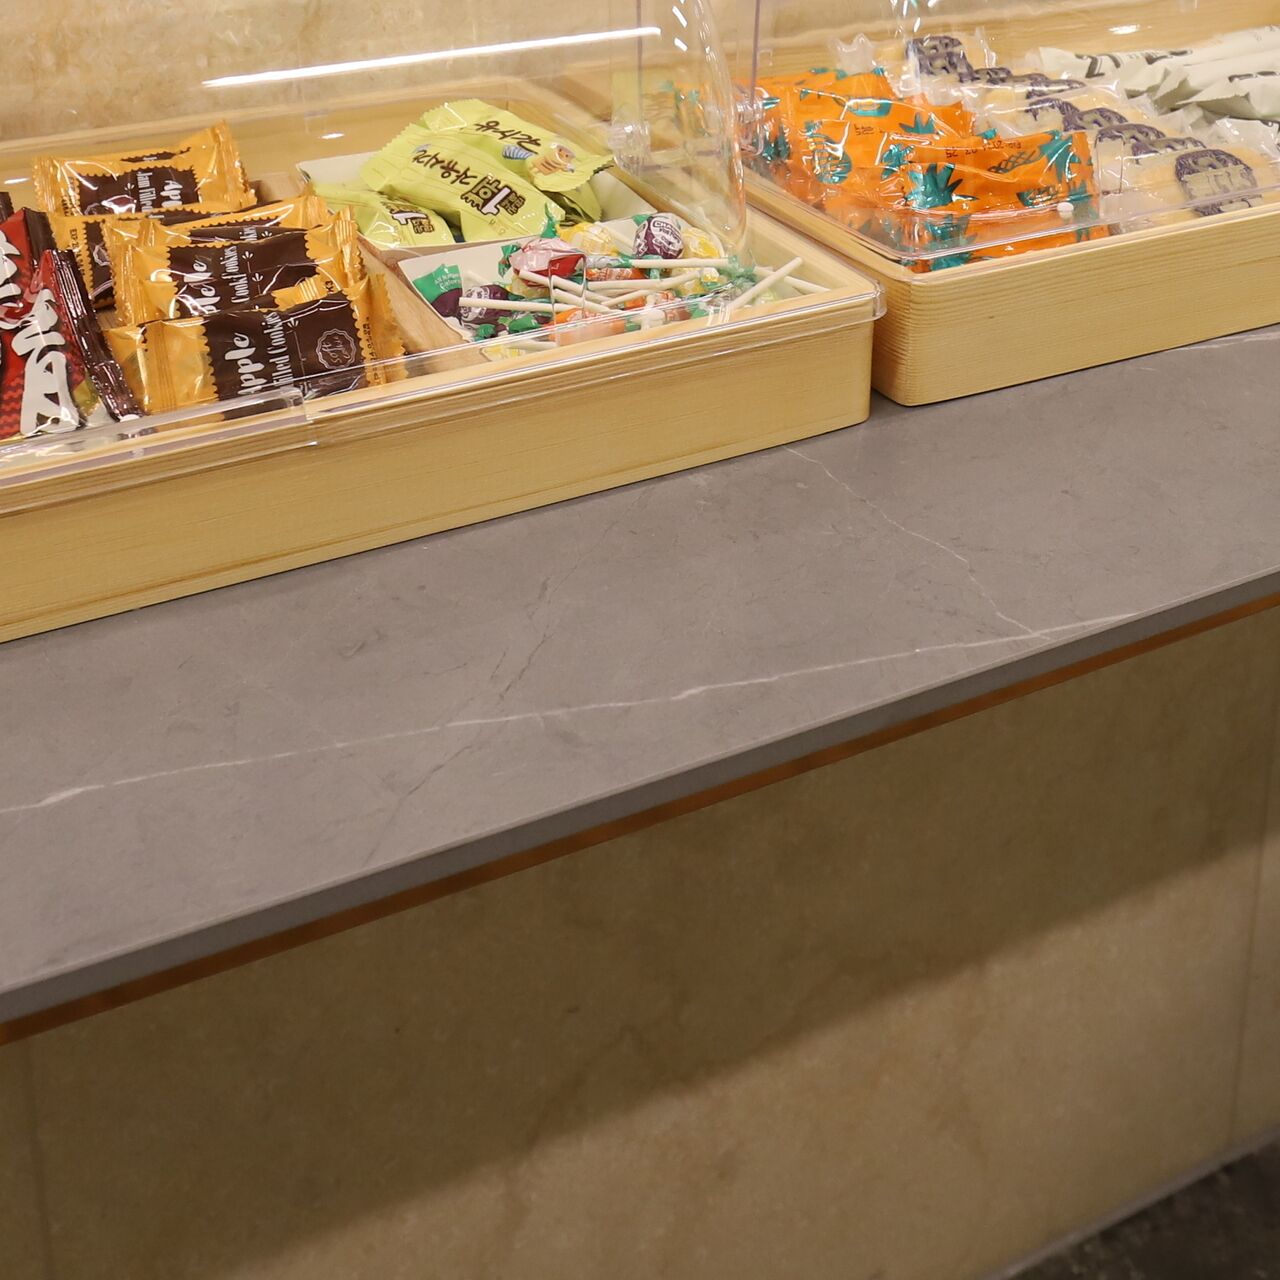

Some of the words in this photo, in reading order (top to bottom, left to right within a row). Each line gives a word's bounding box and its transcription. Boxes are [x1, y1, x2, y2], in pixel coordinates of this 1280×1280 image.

[474, 120, 542, 155] 유시간
[411, 149, 478, 186] 자유시간
[260, 310, 288, 355] Cookies
[223, 332, 268, 396] Apple
